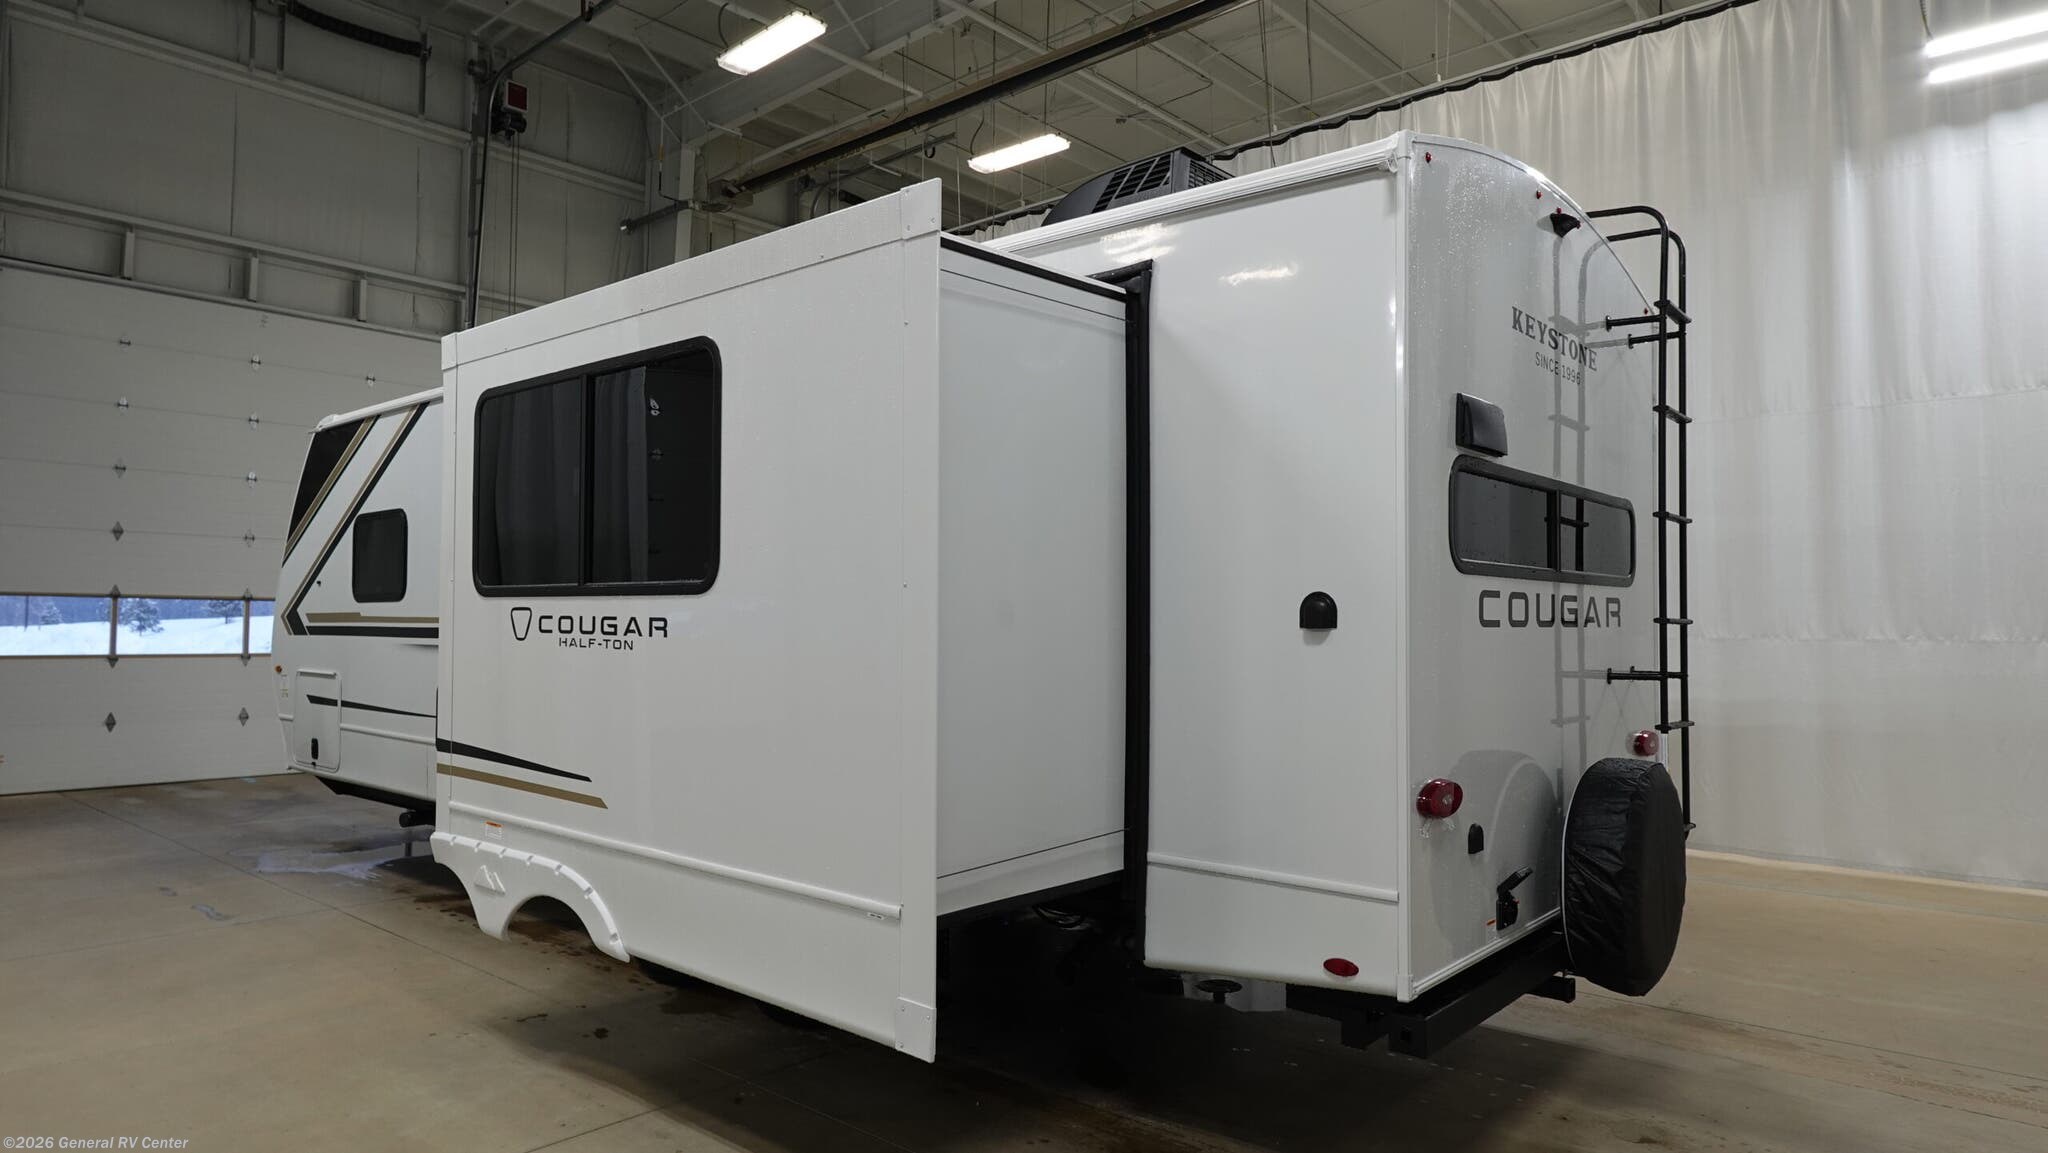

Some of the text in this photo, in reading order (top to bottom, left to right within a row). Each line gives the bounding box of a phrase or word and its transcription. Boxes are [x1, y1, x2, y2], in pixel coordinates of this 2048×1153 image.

[1512, 306, 1597, 371] KEYSTONE
[1535, 351, 1581, 385] SINCE 1996
[1479, 590, 1621, 628] COUGAR
[538, 615, 668, 638] COUGAR
[559, 637, 634, 651] HALF-TON
